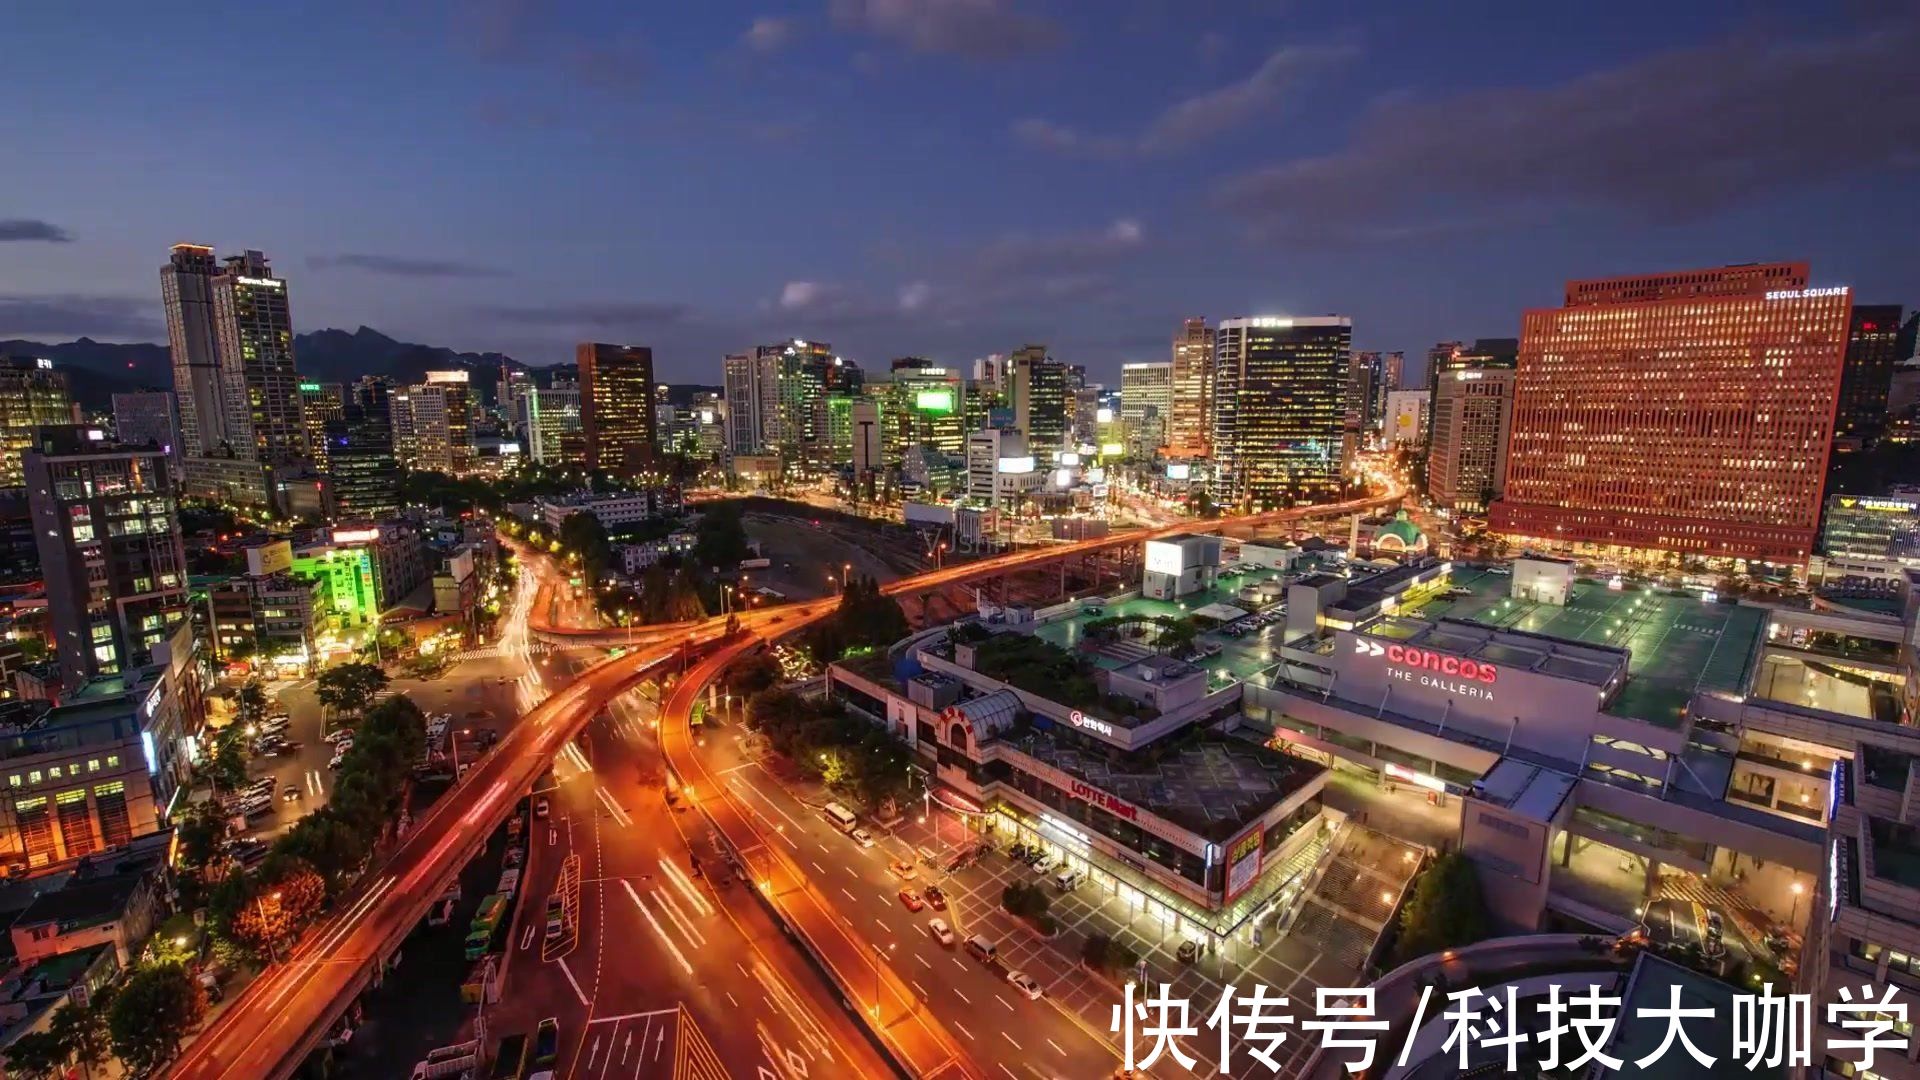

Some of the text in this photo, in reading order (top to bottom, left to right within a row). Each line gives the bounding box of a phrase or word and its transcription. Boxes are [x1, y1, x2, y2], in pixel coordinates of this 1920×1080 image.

[1766, 287, 1849, 300] SEOUL SQUARE
[1387, 667, 1494, 701] THE GALLERIA
[1071, 780, 1138, 821] LOTTE Mart
